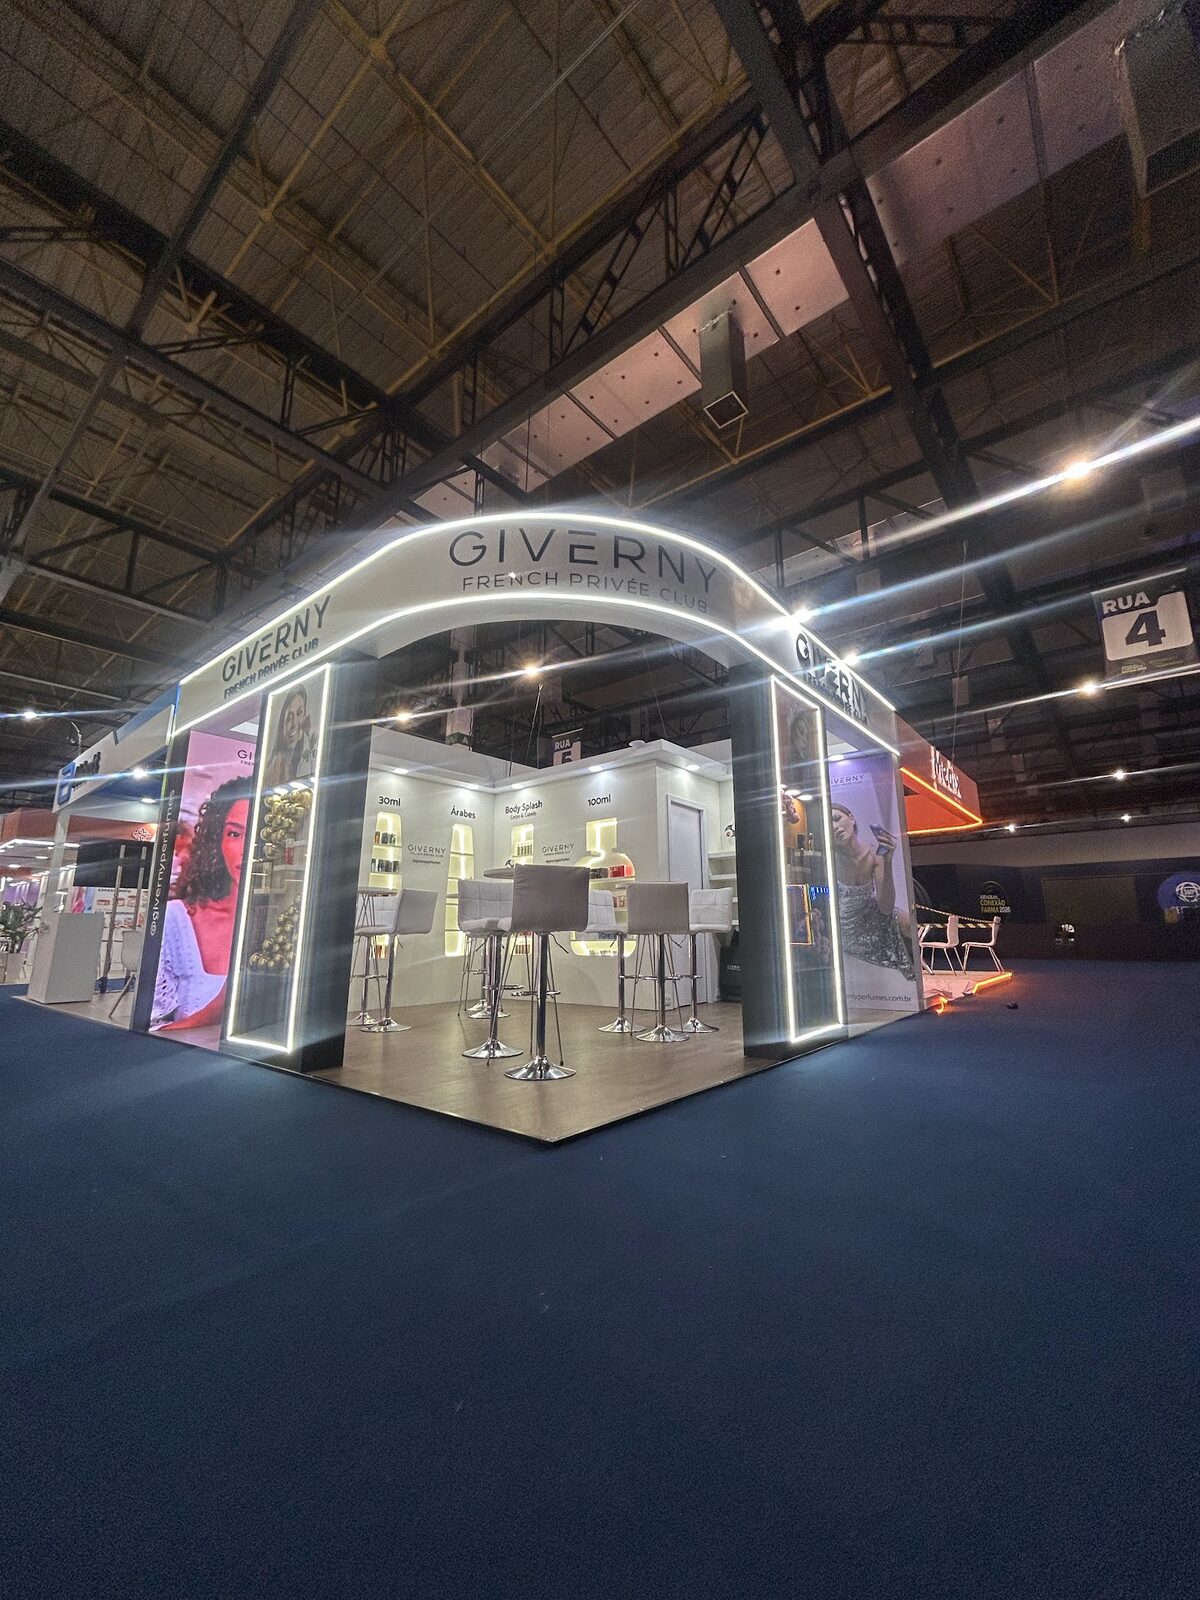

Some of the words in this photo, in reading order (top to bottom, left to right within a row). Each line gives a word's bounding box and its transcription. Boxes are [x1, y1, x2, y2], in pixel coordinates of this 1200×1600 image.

[449, 528, 717, 593] GIVERNY
[462, 571, 558, 591] FRENCH
[569, 573, 649, 597] PRIVÉE
[660, 588, 707, 613] CLUB
[1102, 592, 1150, 614] RUA
[1125, 609, 1166, 647] 4
[222, 594, 331, 682] GIVERNY
[224, 672, 256, 699] FRENCH
[257, 654, 290, 680] PRIVÉE
[292, 637, 320, 660] CLUB
[554, 739, 571, 751] RUA
[378, 795, 401, 806] 30ml
[587, 793, 611, 806] 100ml
[450, 805, 476, 819] Árabes
[505, 804, 521, 815] Body
[522, 800, 543, 813] Splash
[407, 844, 446, 854] GIVERNY
[541, 842, 575, 853] GIVERNY
